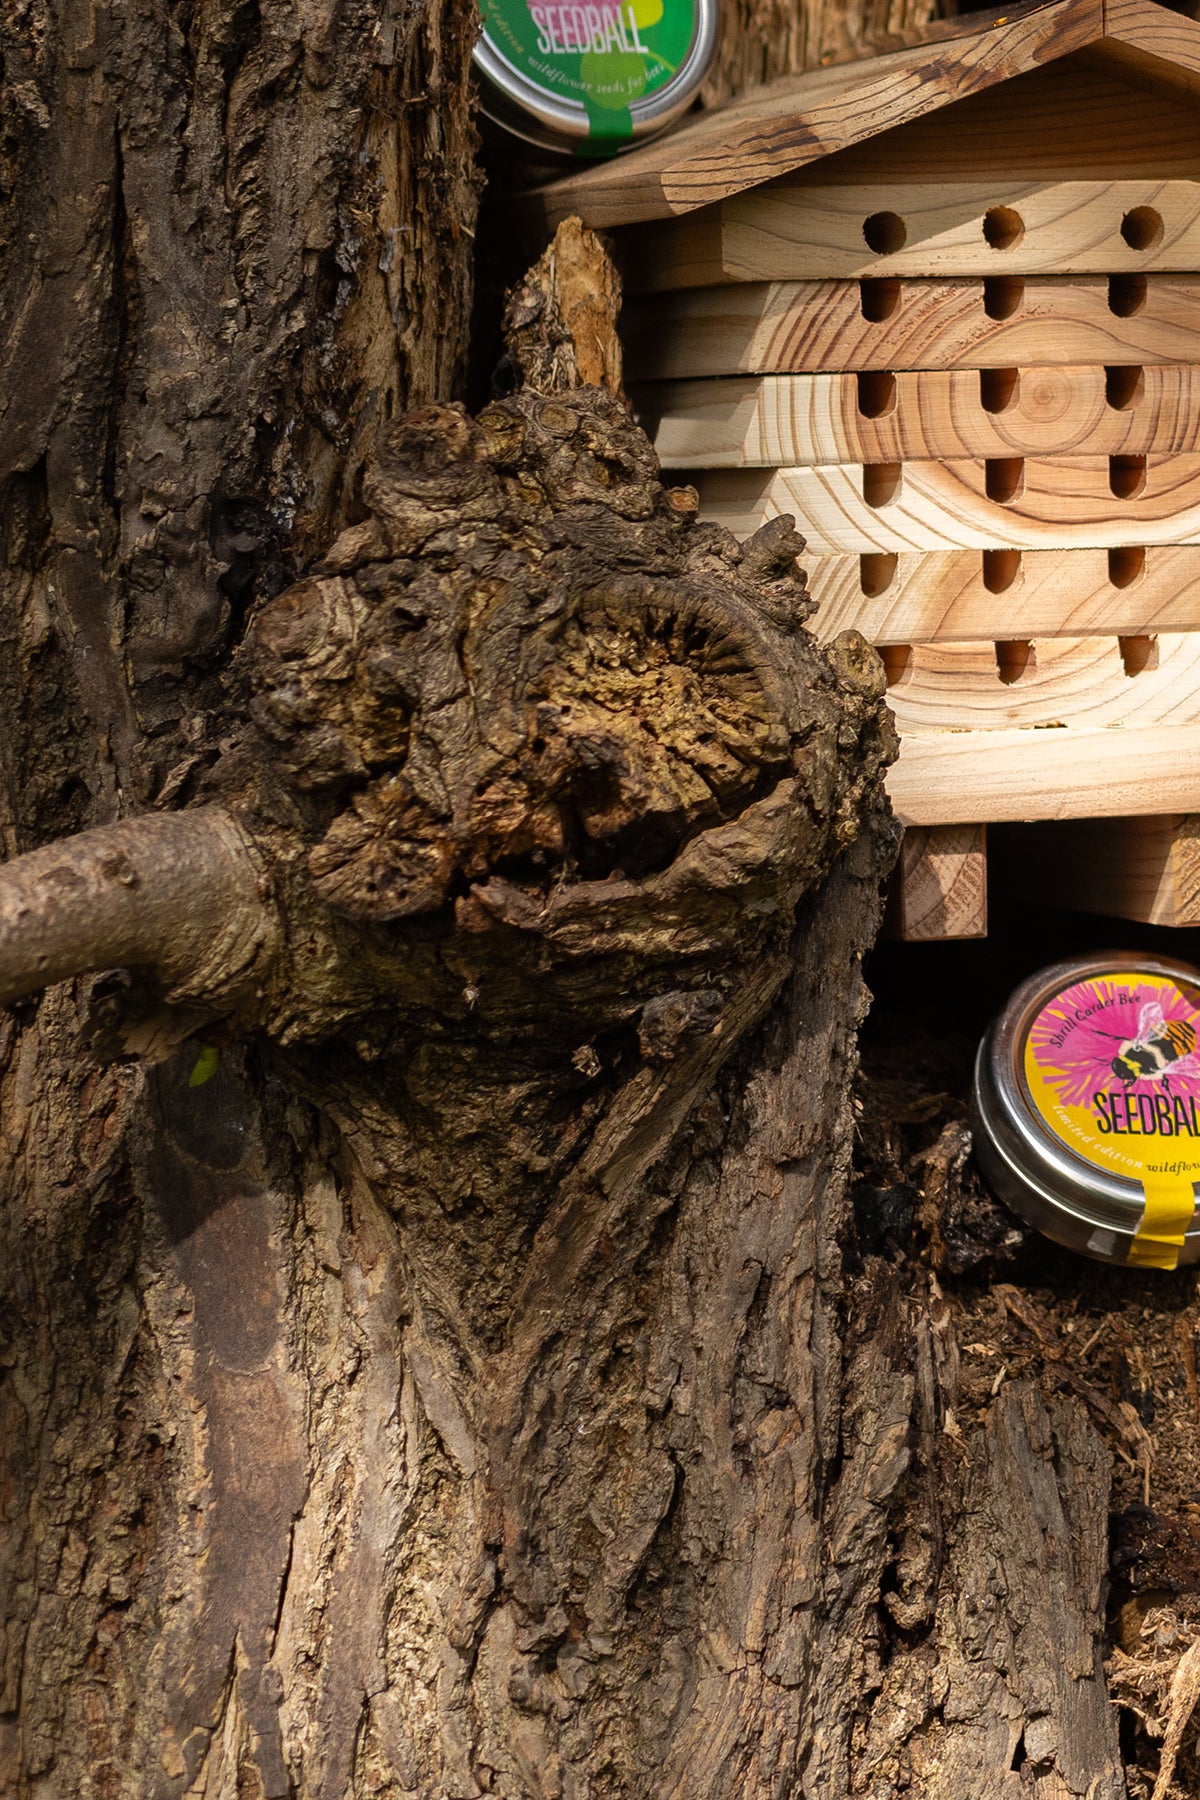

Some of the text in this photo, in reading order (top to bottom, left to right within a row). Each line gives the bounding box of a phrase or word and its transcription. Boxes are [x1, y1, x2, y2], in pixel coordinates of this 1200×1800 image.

[531, 5, 648, 54] SEEDBALL
[528, 55, 594, 91] wildflower
[597, 79, 625, 94] seeds
[627, 76, 643, 95] for
[1050, 993, 1142, 1049] Shrill Carder Bee
[1053, 1104, 1143, 1170] limited edition
